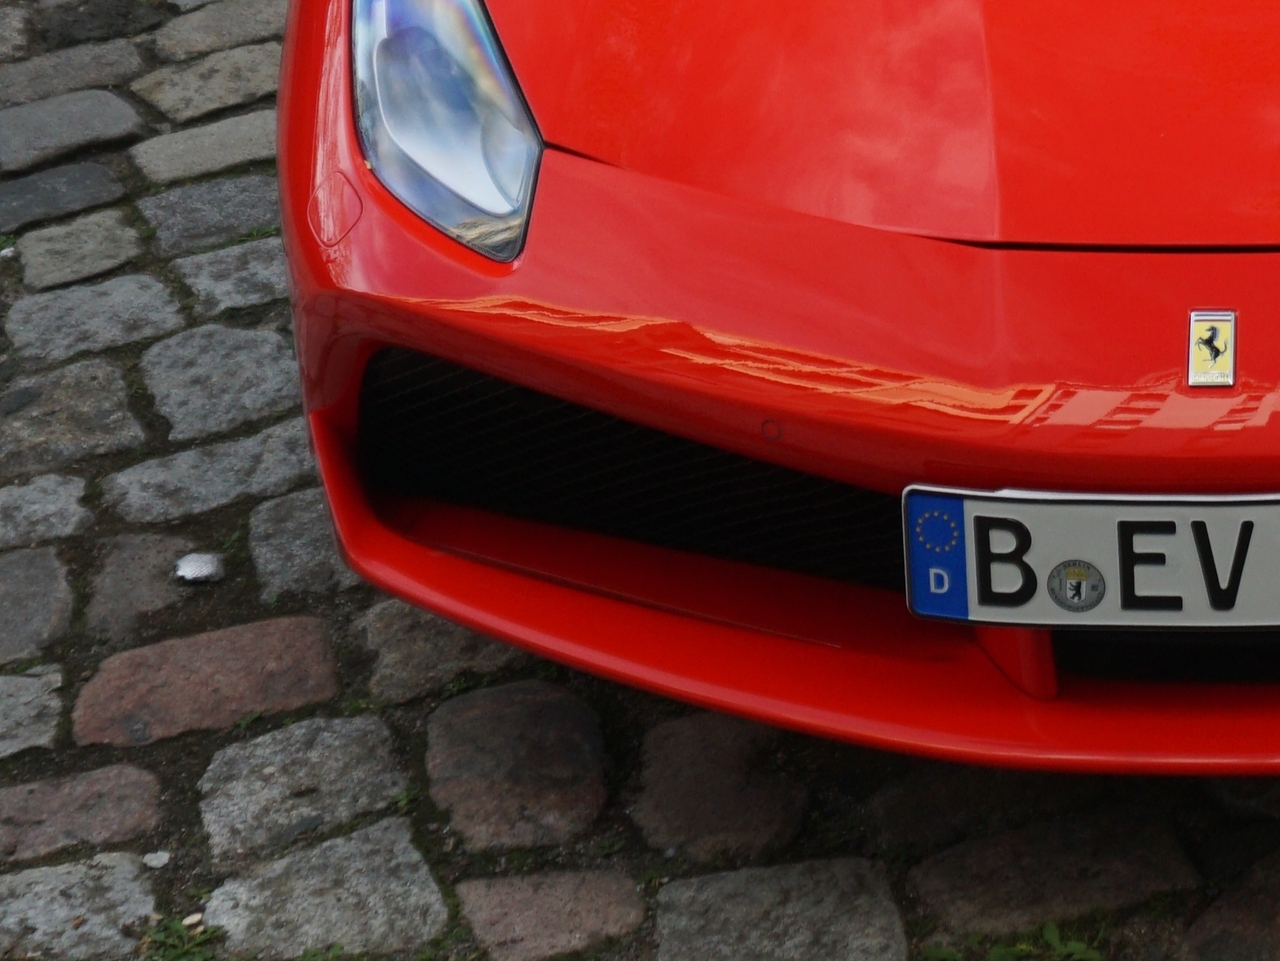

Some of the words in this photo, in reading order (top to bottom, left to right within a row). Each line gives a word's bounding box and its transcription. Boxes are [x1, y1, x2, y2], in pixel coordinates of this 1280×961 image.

[929, 568, 949, 594] D
[973, 515, 1038, 609] B
[1117, 520, 1254, 612] EV
